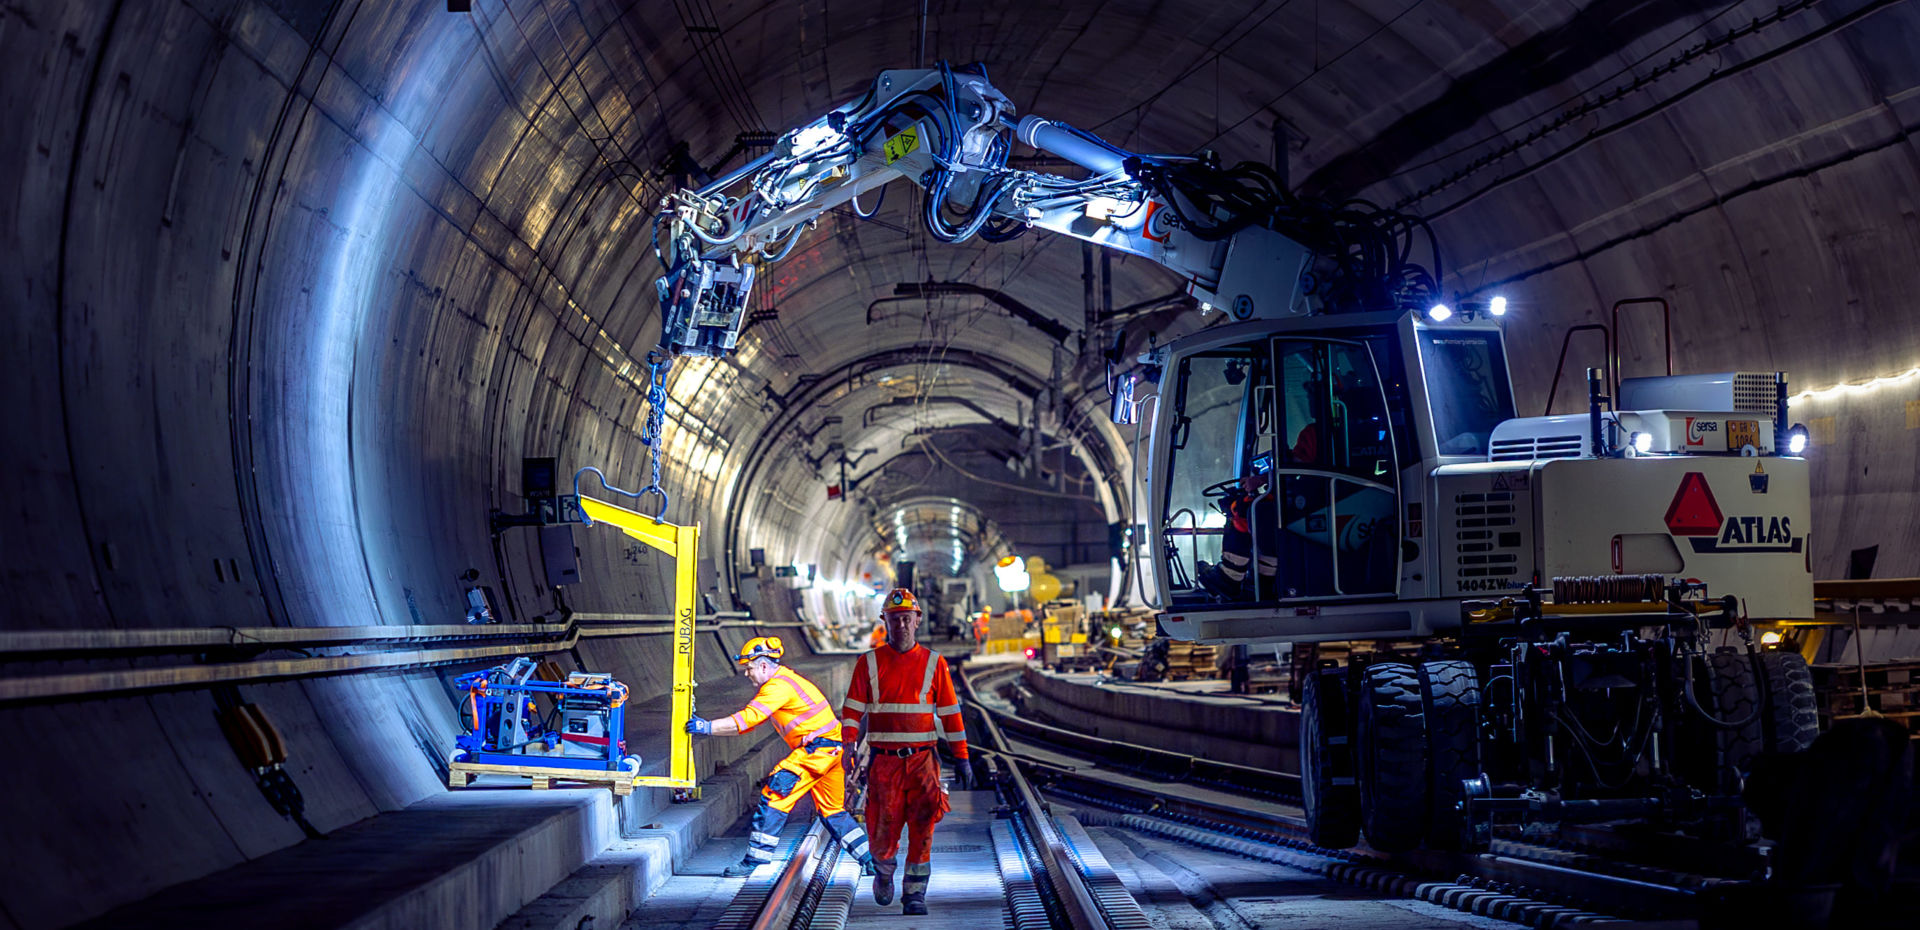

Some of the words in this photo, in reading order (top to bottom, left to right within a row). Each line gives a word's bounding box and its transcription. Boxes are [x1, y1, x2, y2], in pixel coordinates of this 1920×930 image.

[1696, 421, 1717, 432] sersa
[1721, 516, 1791, 543] ATLAS
[679, 608, 692, 654] RUBAG
